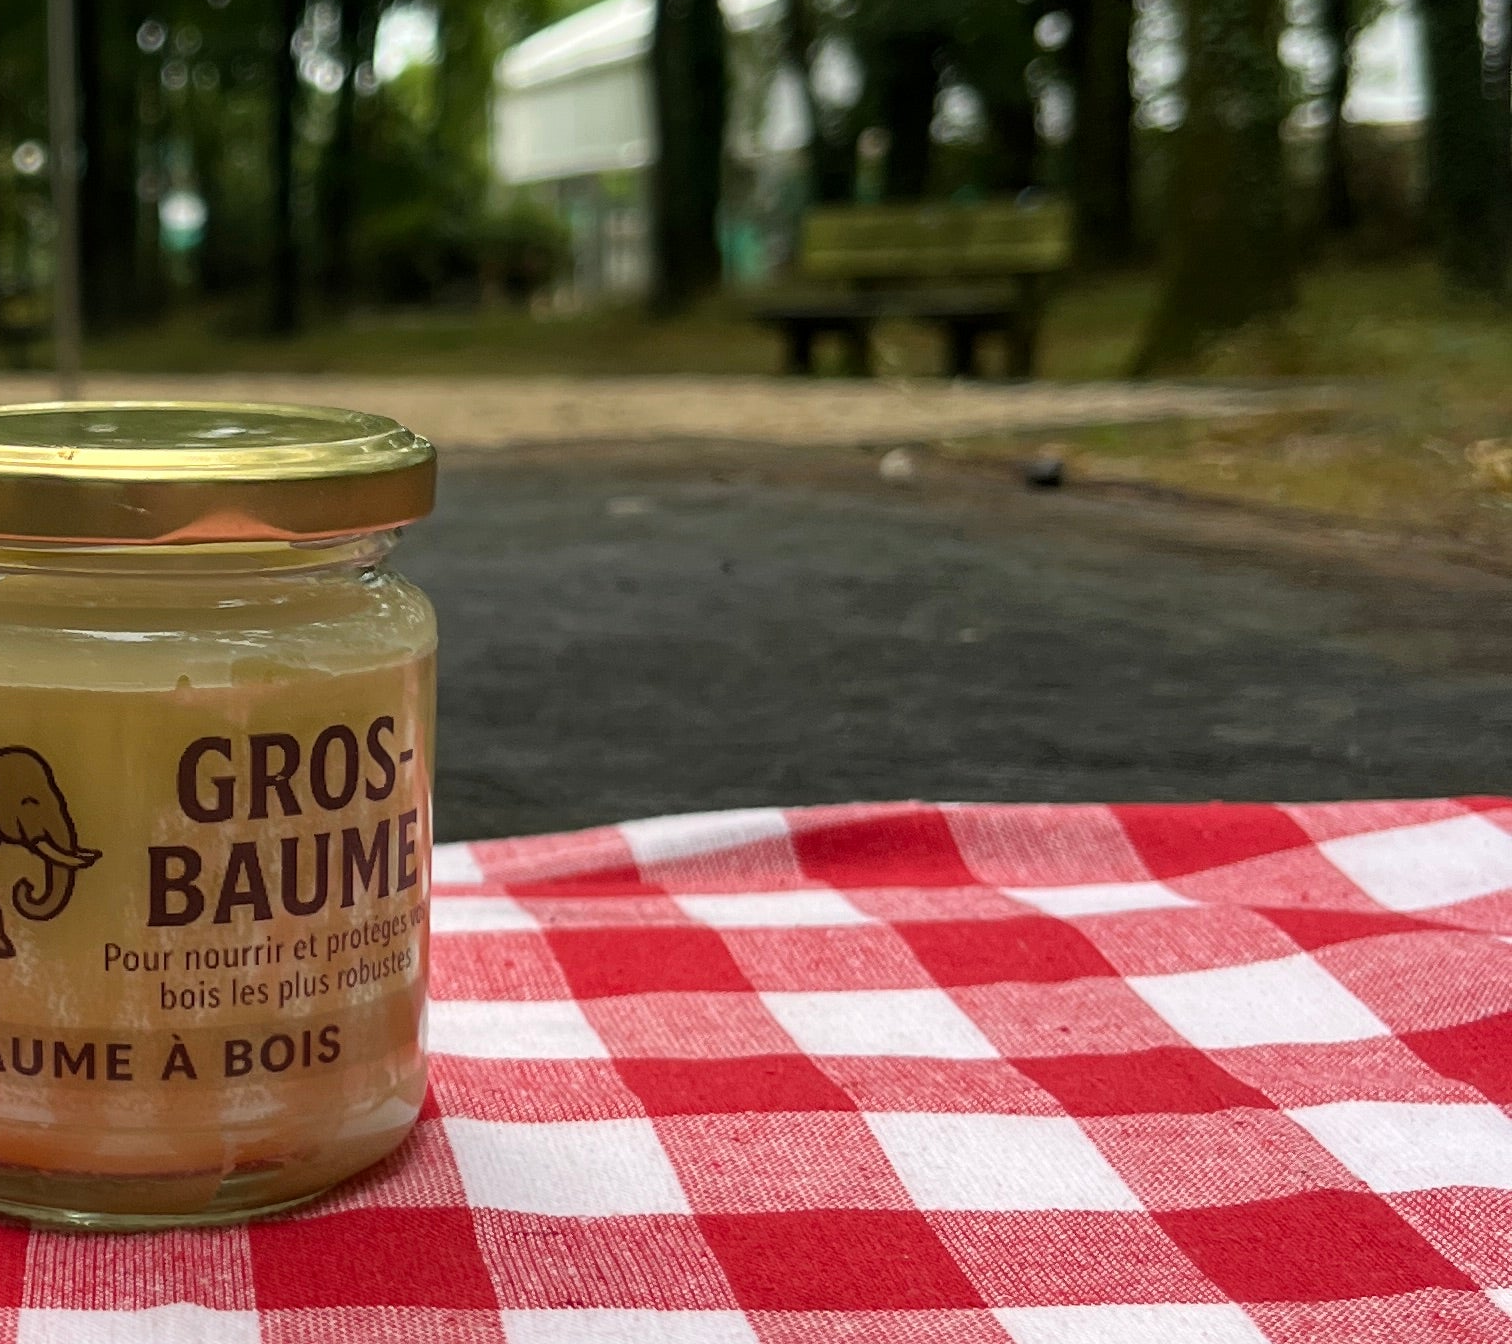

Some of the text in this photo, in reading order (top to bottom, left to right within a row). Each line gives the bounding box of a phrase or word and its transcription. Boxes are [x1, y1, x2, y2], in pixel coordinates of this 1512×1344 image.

[177, 715, 414, 824] GROS-
[147, 808, 418, 927] BAUME
[104, 942, 174, 972] Pour
[185, 935, 285, 971] nourrir
[293, 933, 318, 960] et
[160, 947, 412, 1010] bois les plus robustes
[161, 1034, 198, 1081] À
[223, 1024, 342, 1078] BOIS
